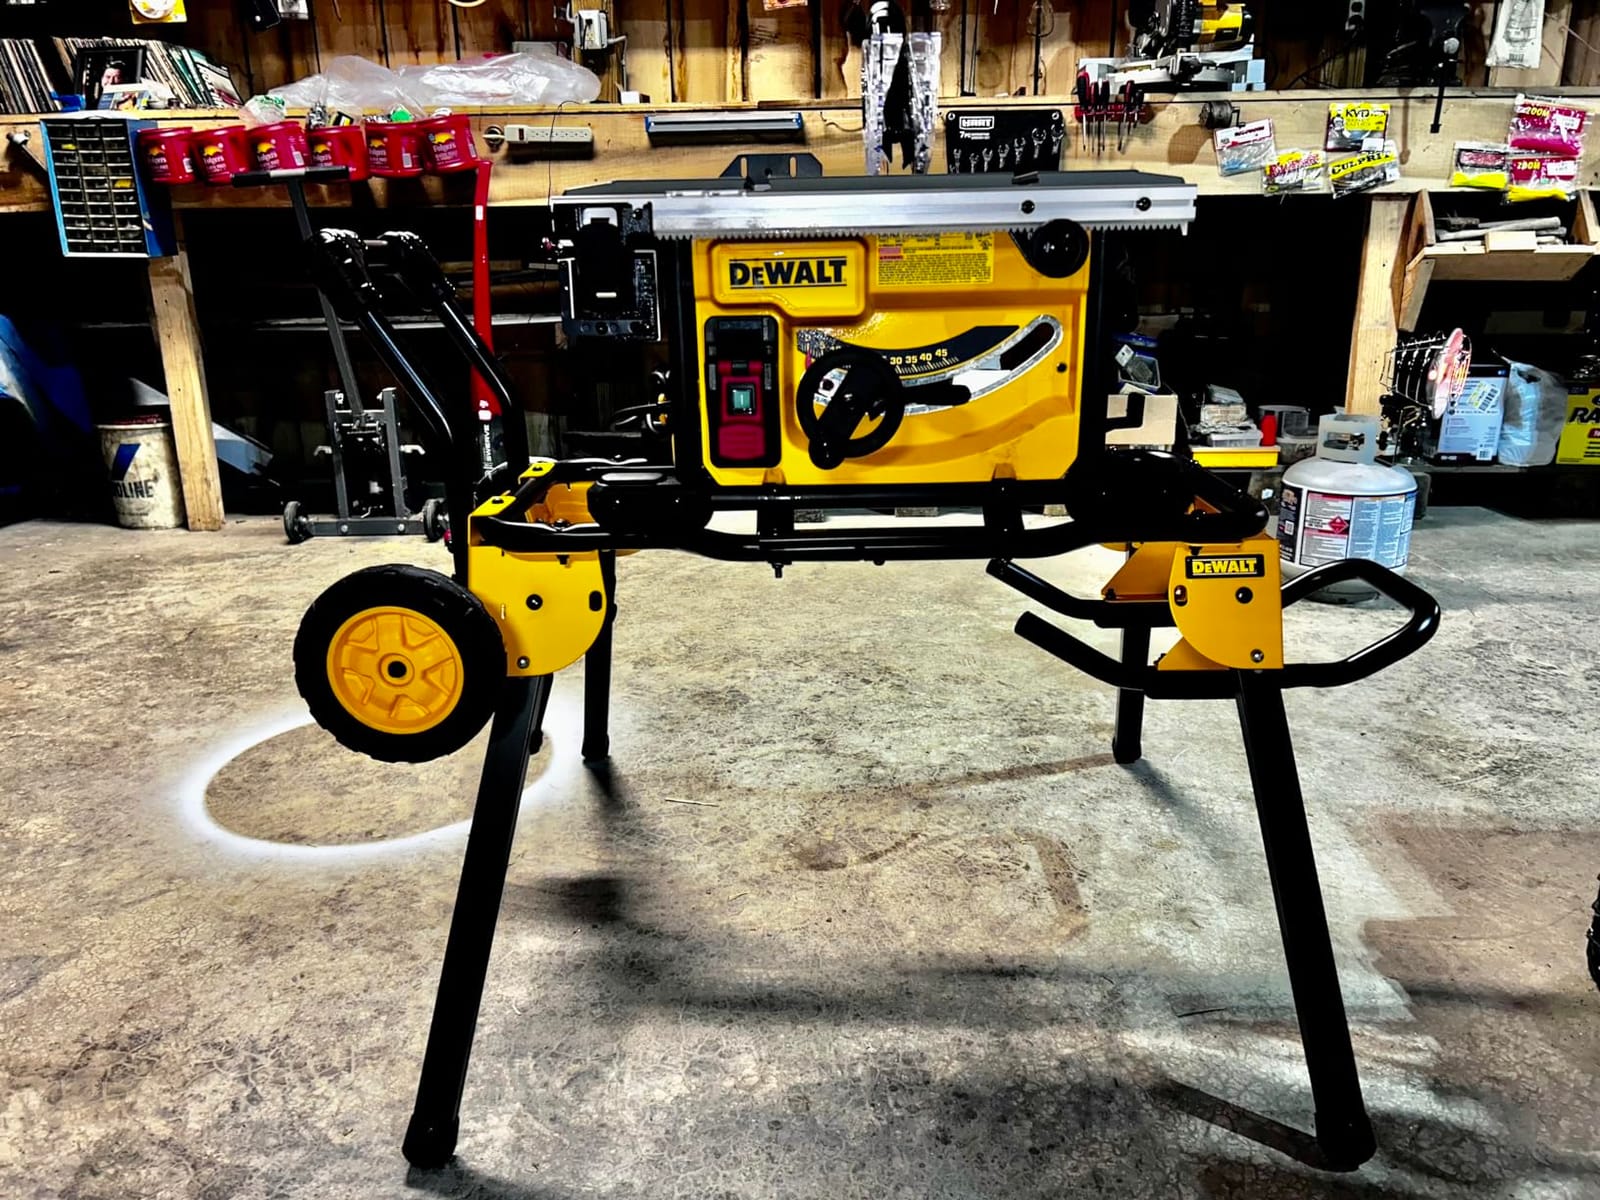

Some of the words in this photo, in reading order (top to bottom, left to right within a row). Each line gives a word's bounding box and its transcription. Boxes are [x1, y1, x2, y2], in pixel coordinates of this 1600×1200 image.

[1345, 109, 1370, 118] KVD
[890, 356, 903, 365] 30
[905, 355, 918, 364] 35
[920, 352, 933, 361] 40
[935, 348, 948, 357] 45
